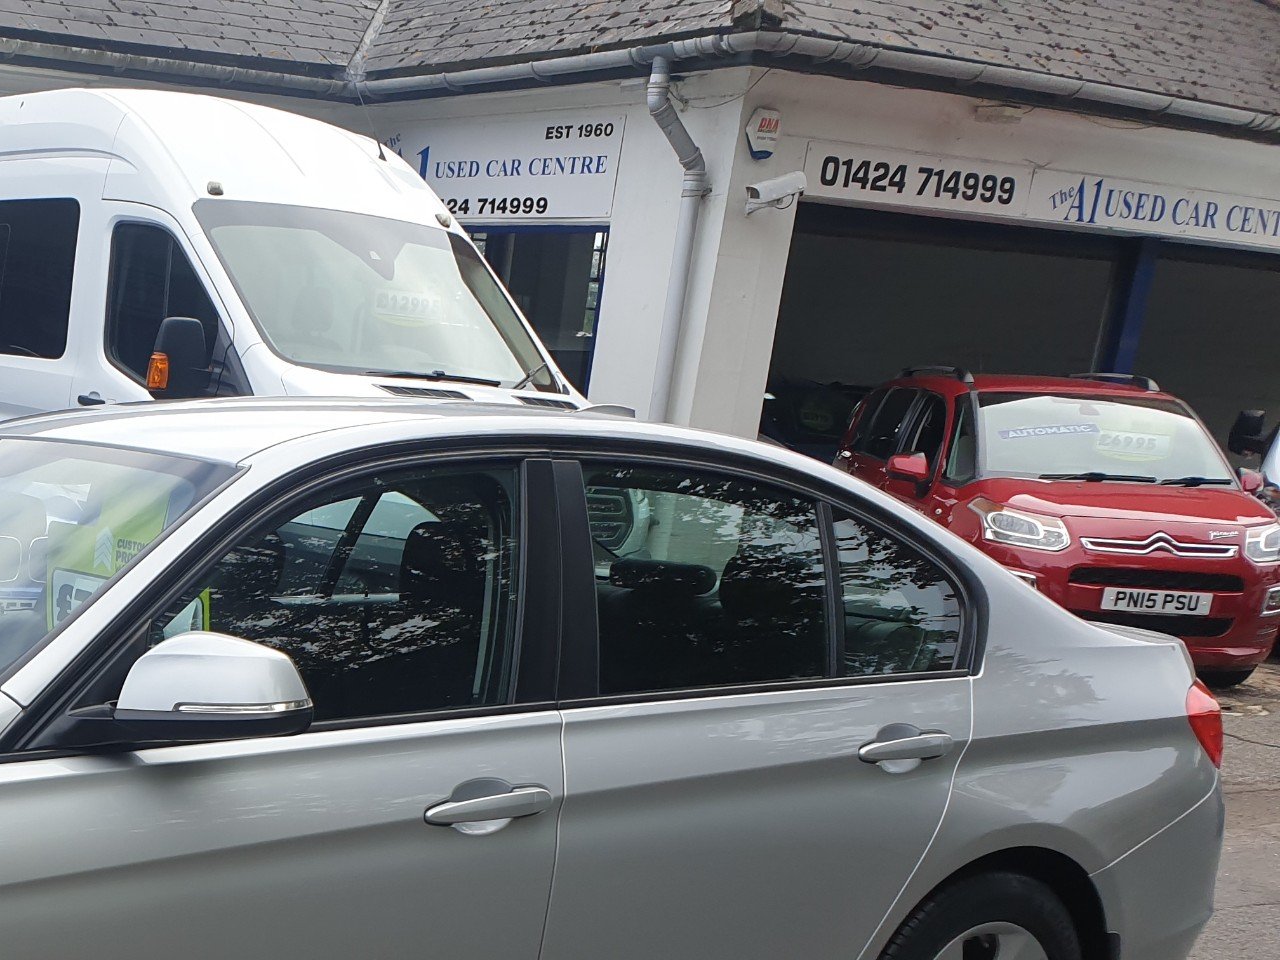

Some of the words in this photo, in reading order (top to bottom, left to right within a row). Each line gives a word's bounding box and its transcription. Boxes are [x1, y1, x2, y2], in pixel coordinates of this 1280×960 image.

[545, 125, 573, 140] EST
[577, 123, 614, 138] 1960
[435, 160, 480, 179] USED
[486, 158, 522, 178] CAR
[528, 155, 608, 176] CENTRE
[820, 156, 908, 194] 01424
[916, 167, 1016, 205] 714999
[440, 198, 470, 215] 24
[478, 197, 548, 214] 714999
[1048, 185, 1076, 211] The
[1063, 176, 1104, 224] A1
[1104, 189, 1166, 222] USED
[1172, 198, 1218, 228] CAR
[1008, 424, 1092, 438] AUTOMATIC
[1098, 433, 1157, 450] £6995
[117, 538, 148, 551] CUSTO
[115, 550, 137, 563] PRO
[1114, 591, 1158, 609] PN15
[1162, 594, 1200, 611] PSU
